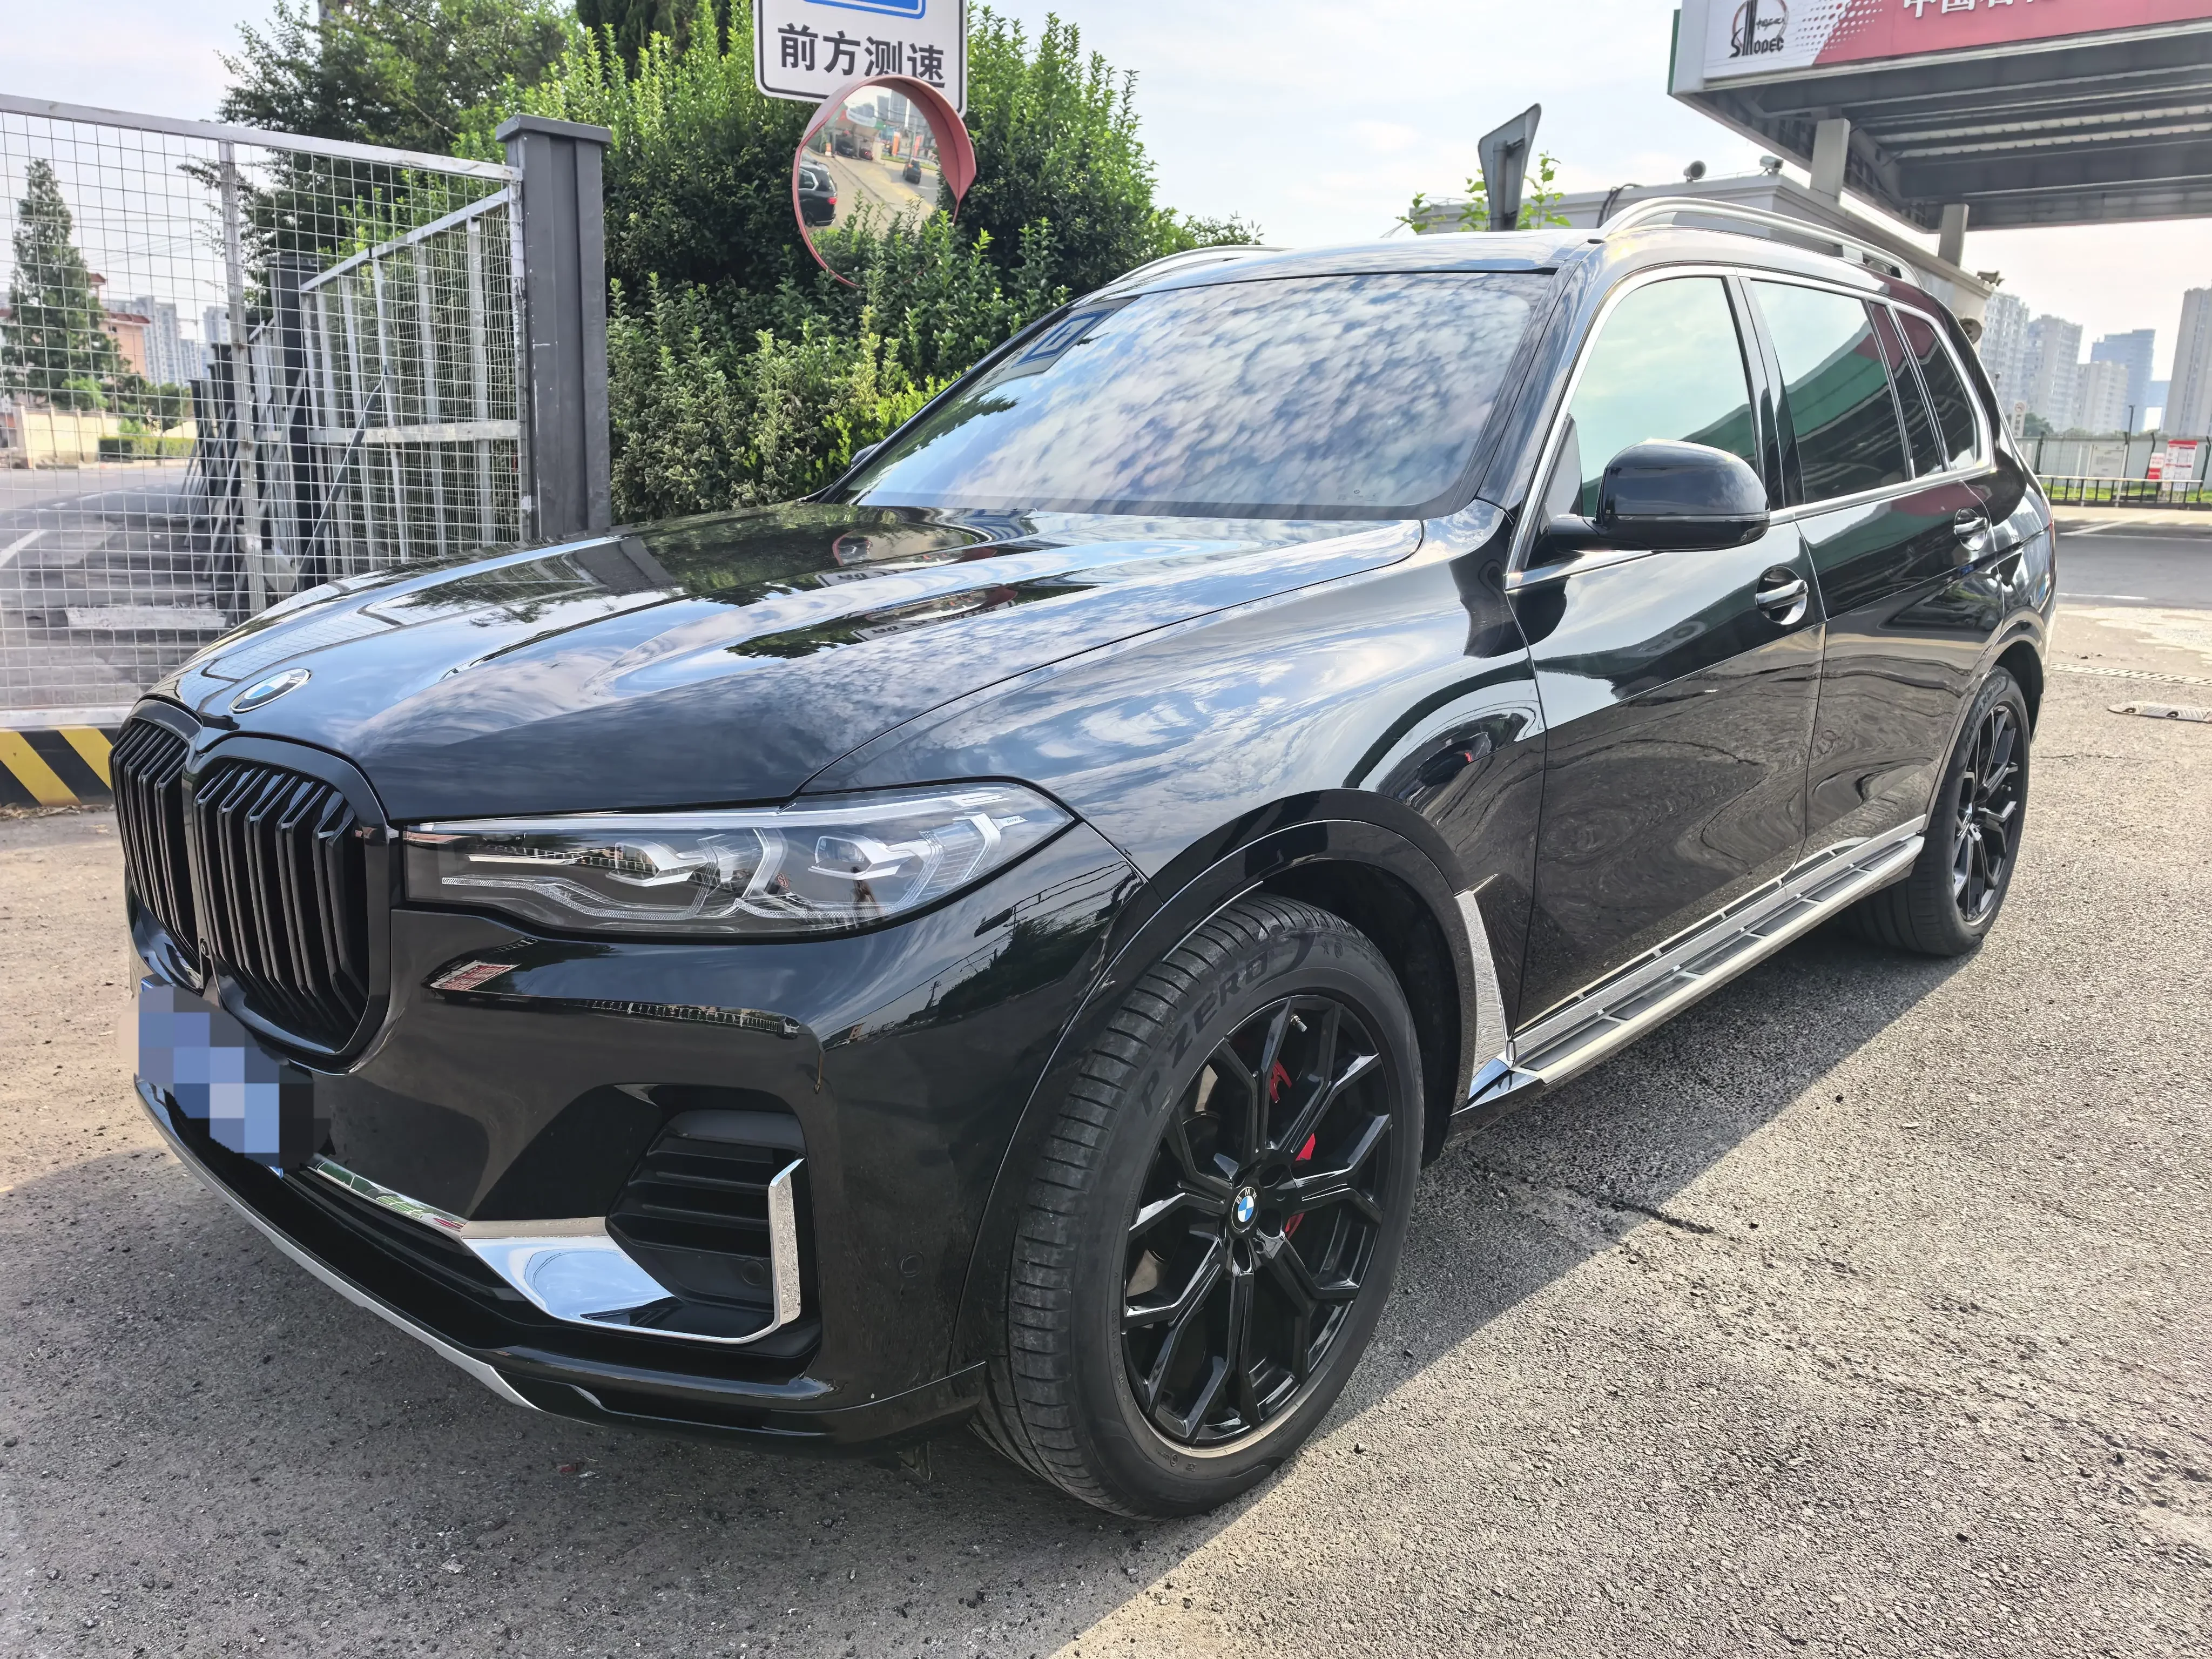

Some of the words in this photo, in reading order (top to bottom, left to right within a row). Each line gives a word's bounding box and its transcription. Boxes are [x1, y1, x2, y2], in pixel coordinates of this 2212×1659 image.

[778, 23, 946, 88] 前方测速
[1141, 1070, 1159, 1119] P
[1167, 951, 1268, 1069] ZERO
[1236, 1188, 1257, 1204] BMW
